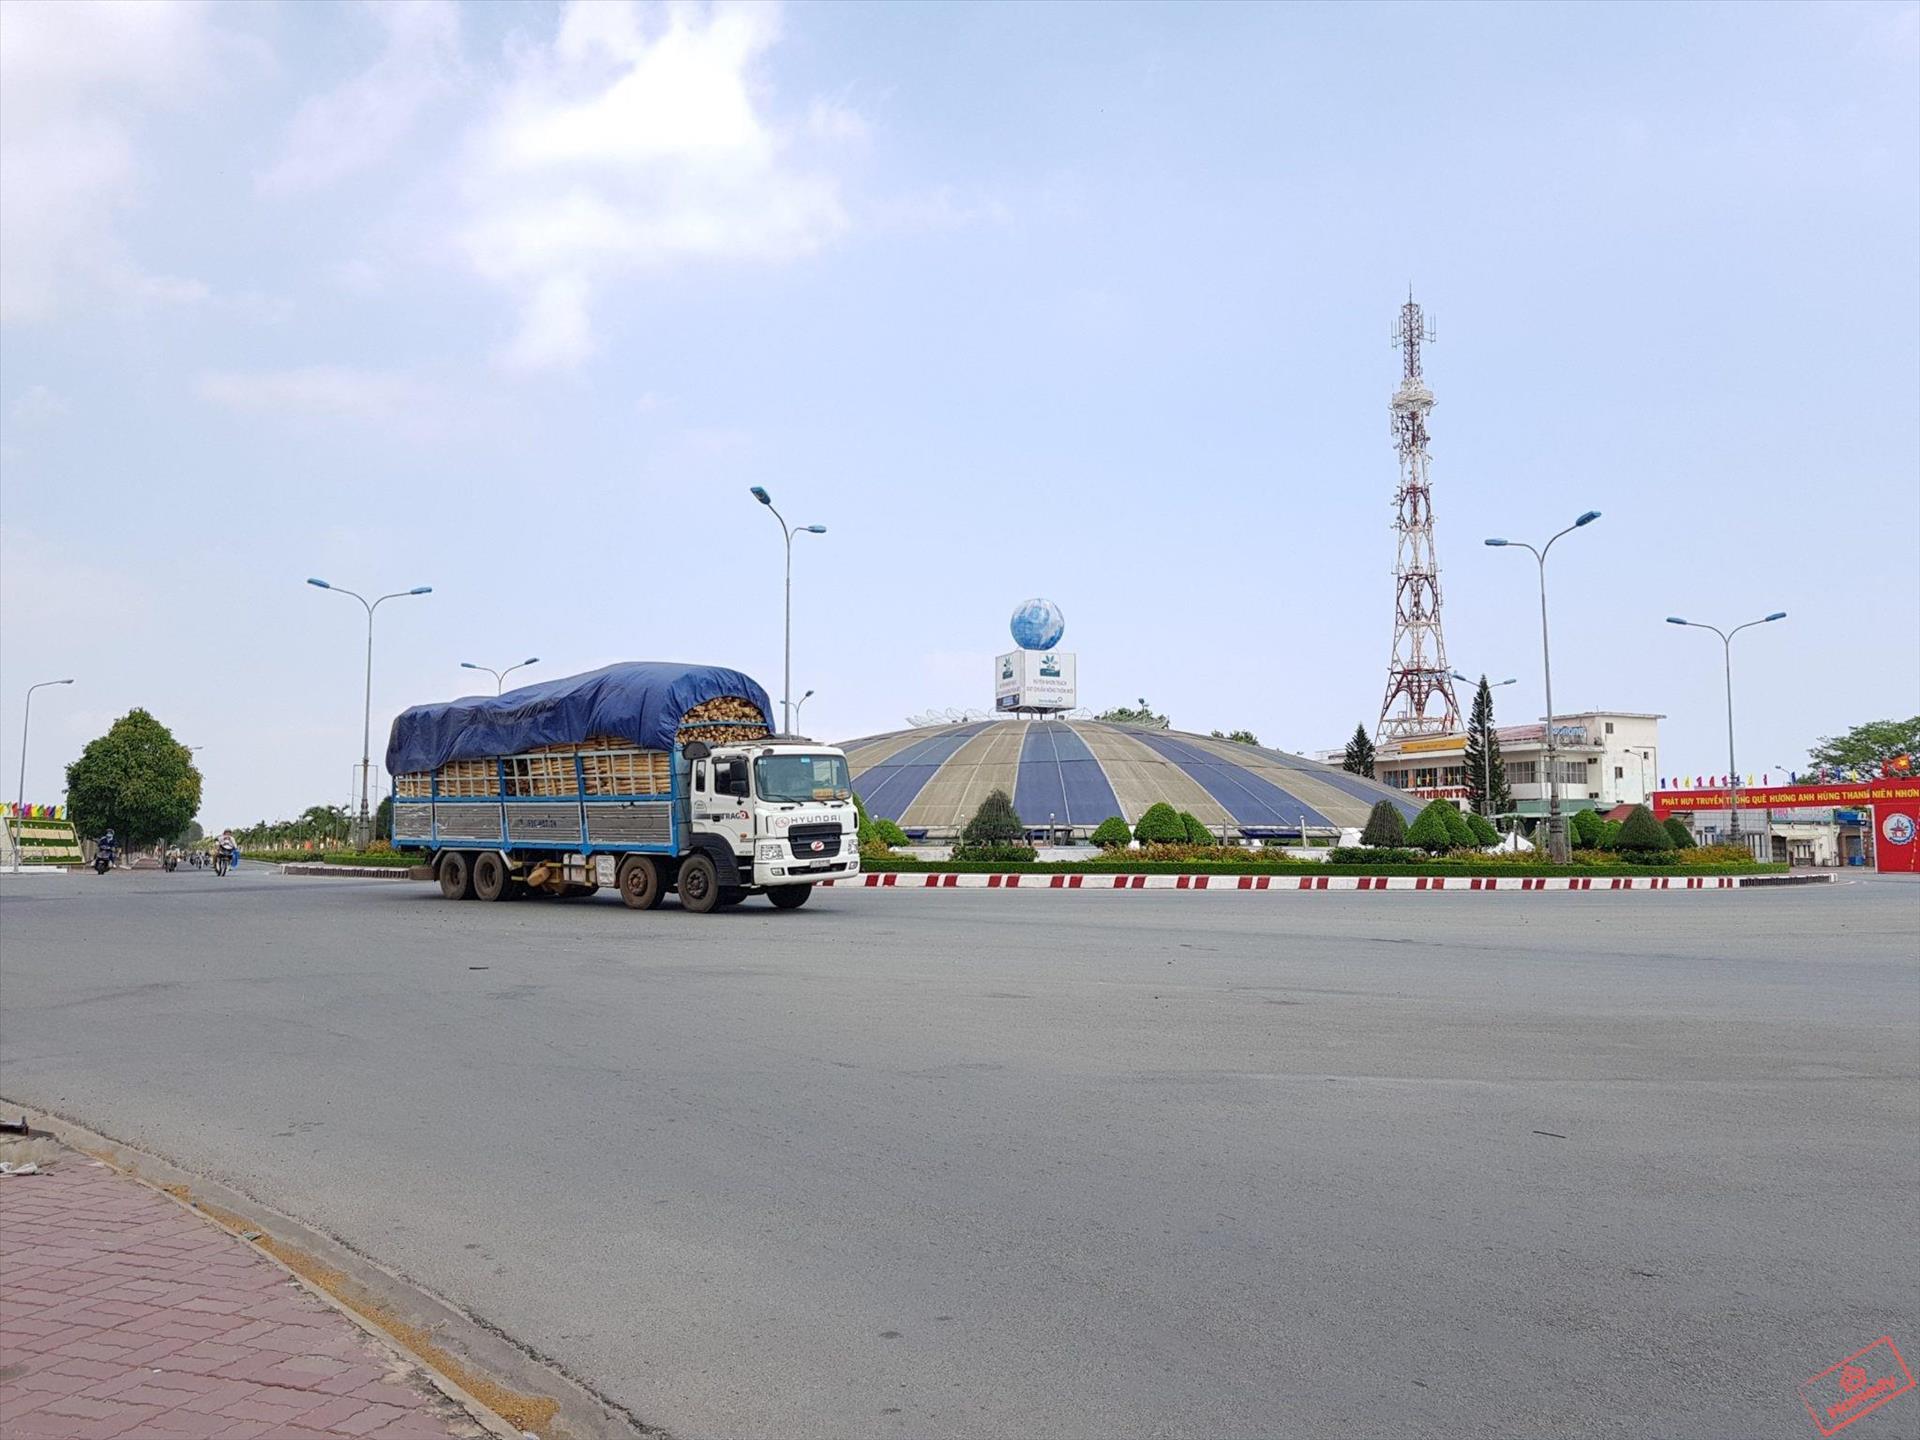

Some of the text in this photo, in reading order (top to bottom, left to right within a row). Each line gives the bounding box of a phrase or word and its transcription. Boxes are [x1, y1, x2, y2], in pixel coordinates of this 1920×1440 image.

[1661, 796, 1679, 806] PHÁT
[1680, 797, 1694, 806] HUY
[1798, 793, 1815, 802] ANH
[1841, 789, 1870, 800] THANH
[791, 814, 841, 824] HYUNDAI
